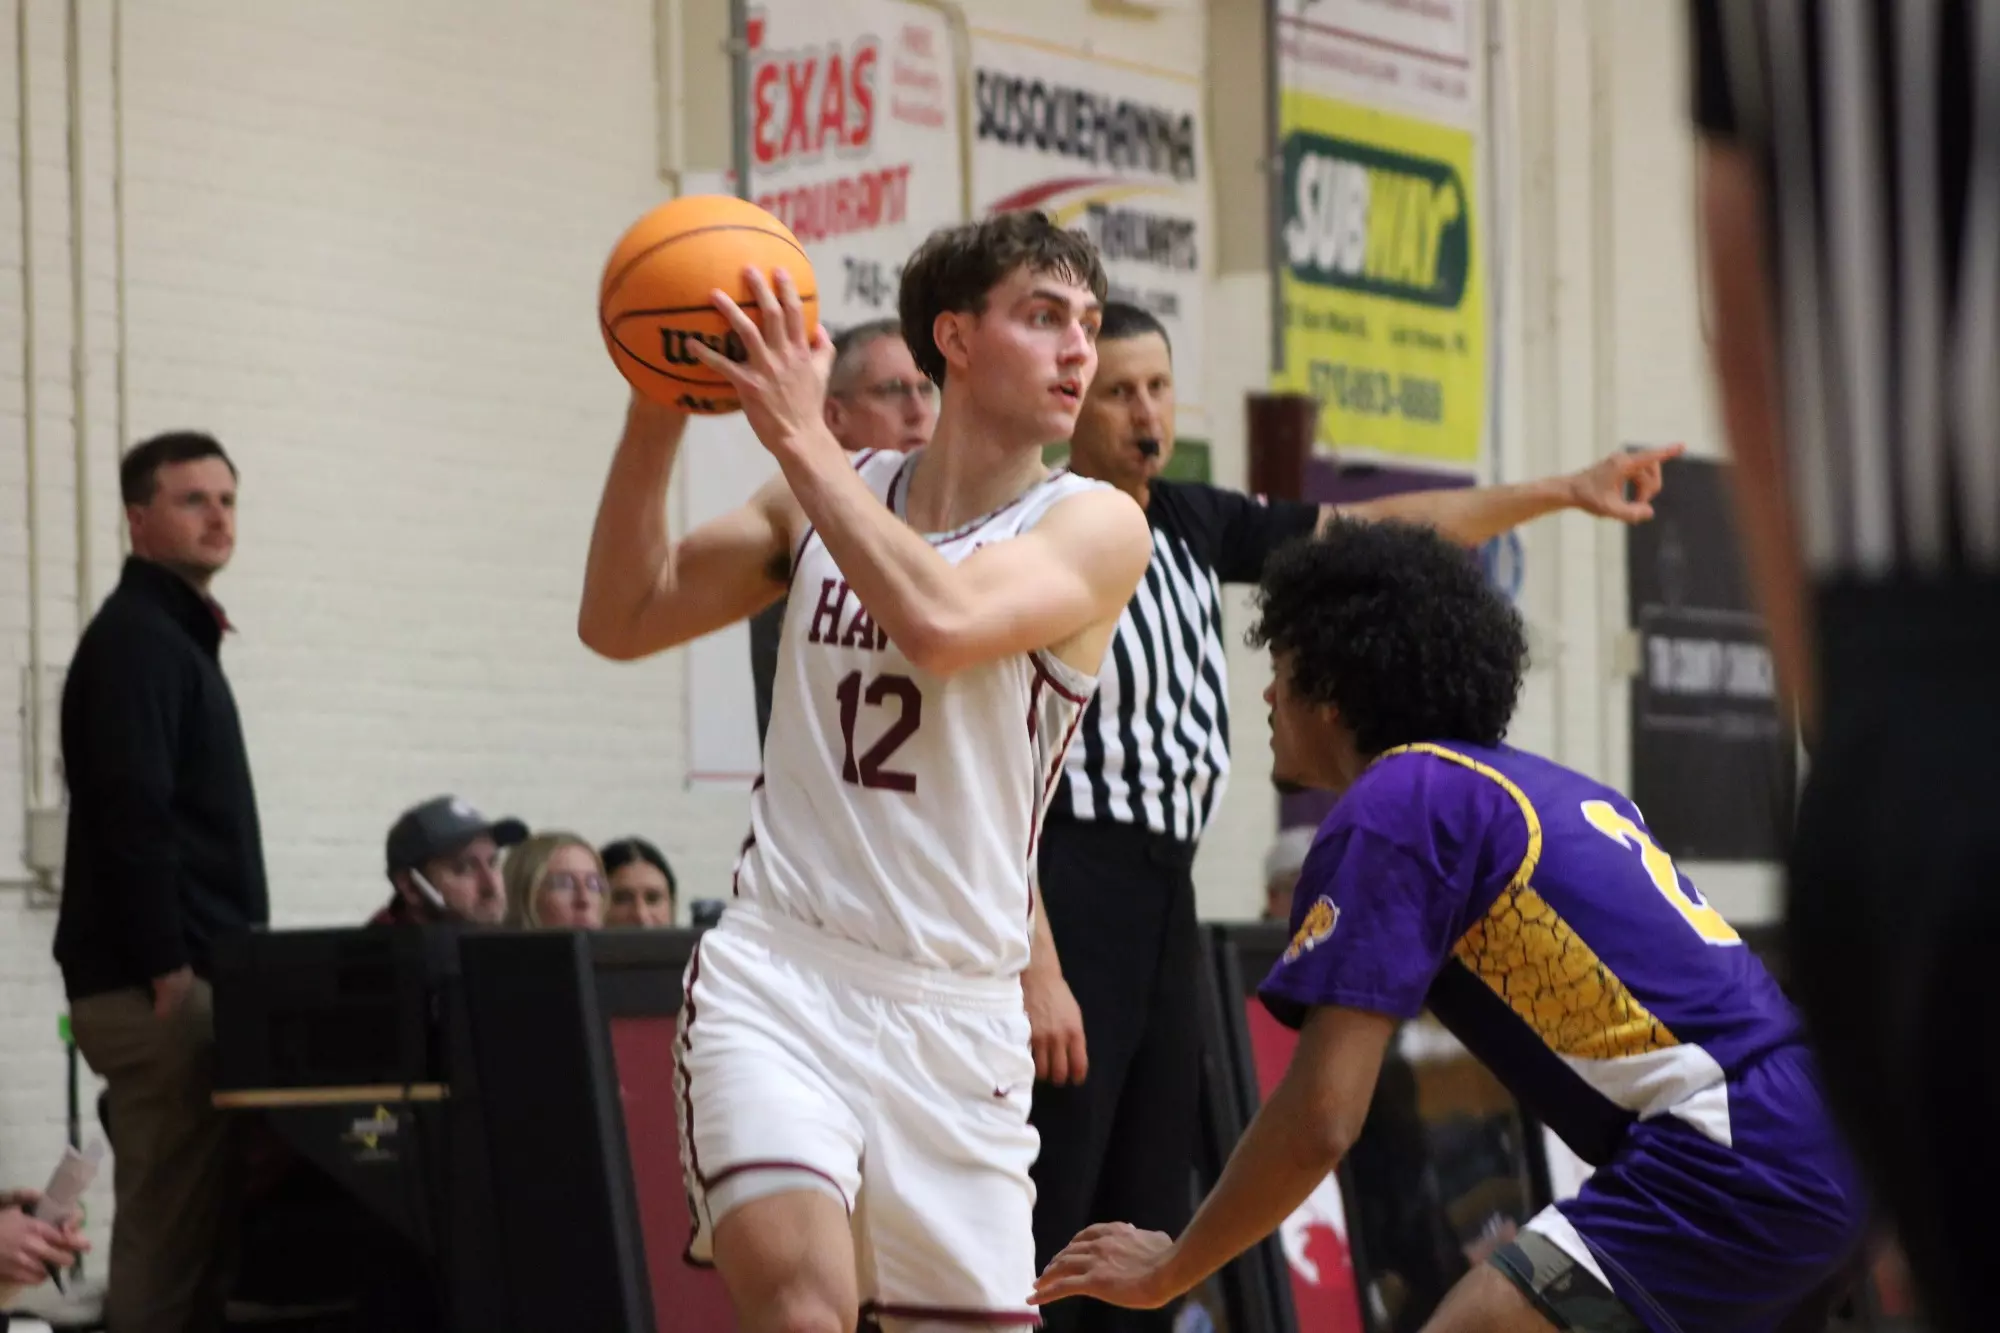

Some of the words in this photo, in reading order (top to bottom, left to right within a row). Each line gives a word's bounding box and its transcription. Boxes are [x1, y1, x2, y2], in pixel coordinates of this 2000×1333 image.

[975, 67, 1198, 182] SUSQUEHANNA
[1283, 150, 1459, 292] SUBWAY
[836, 669, 922, 794] 12
